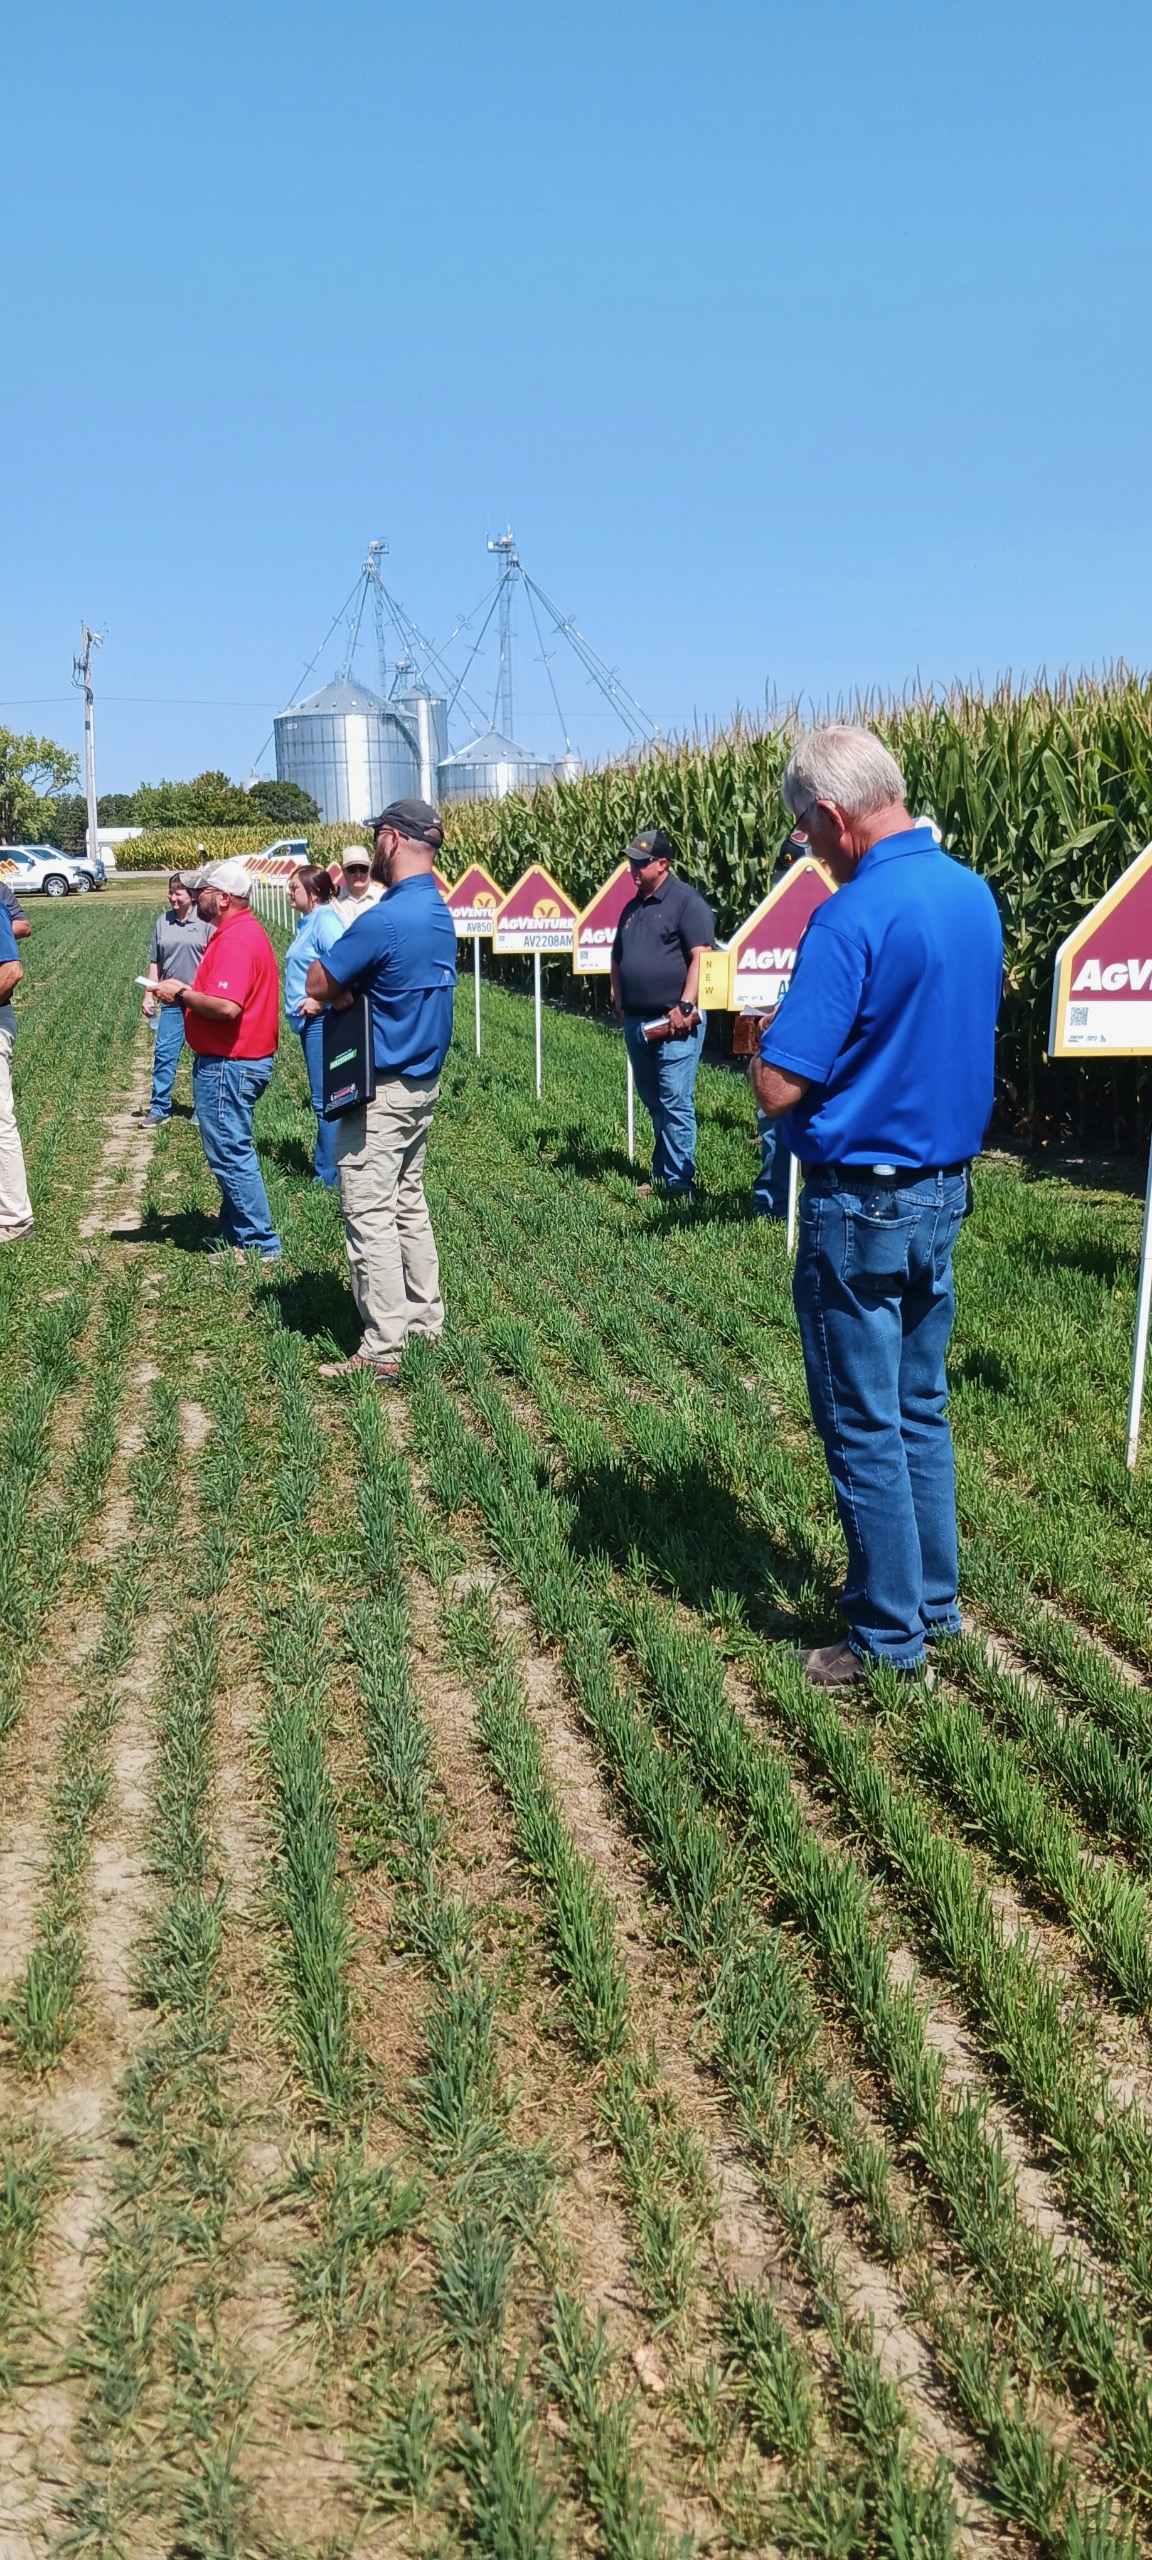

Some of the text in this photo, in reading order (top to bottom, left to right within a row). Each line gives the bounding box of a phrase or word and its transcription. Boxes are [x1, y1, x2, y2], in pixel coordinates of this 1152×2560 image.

[467, 922, 493, 932] AV850
[524, 935, 573, 947] AV2208AM
[705, 960, 714, 994] NEW
[1071, 959, 1152, 991] AGV
[777, 980, 790, 999] A
